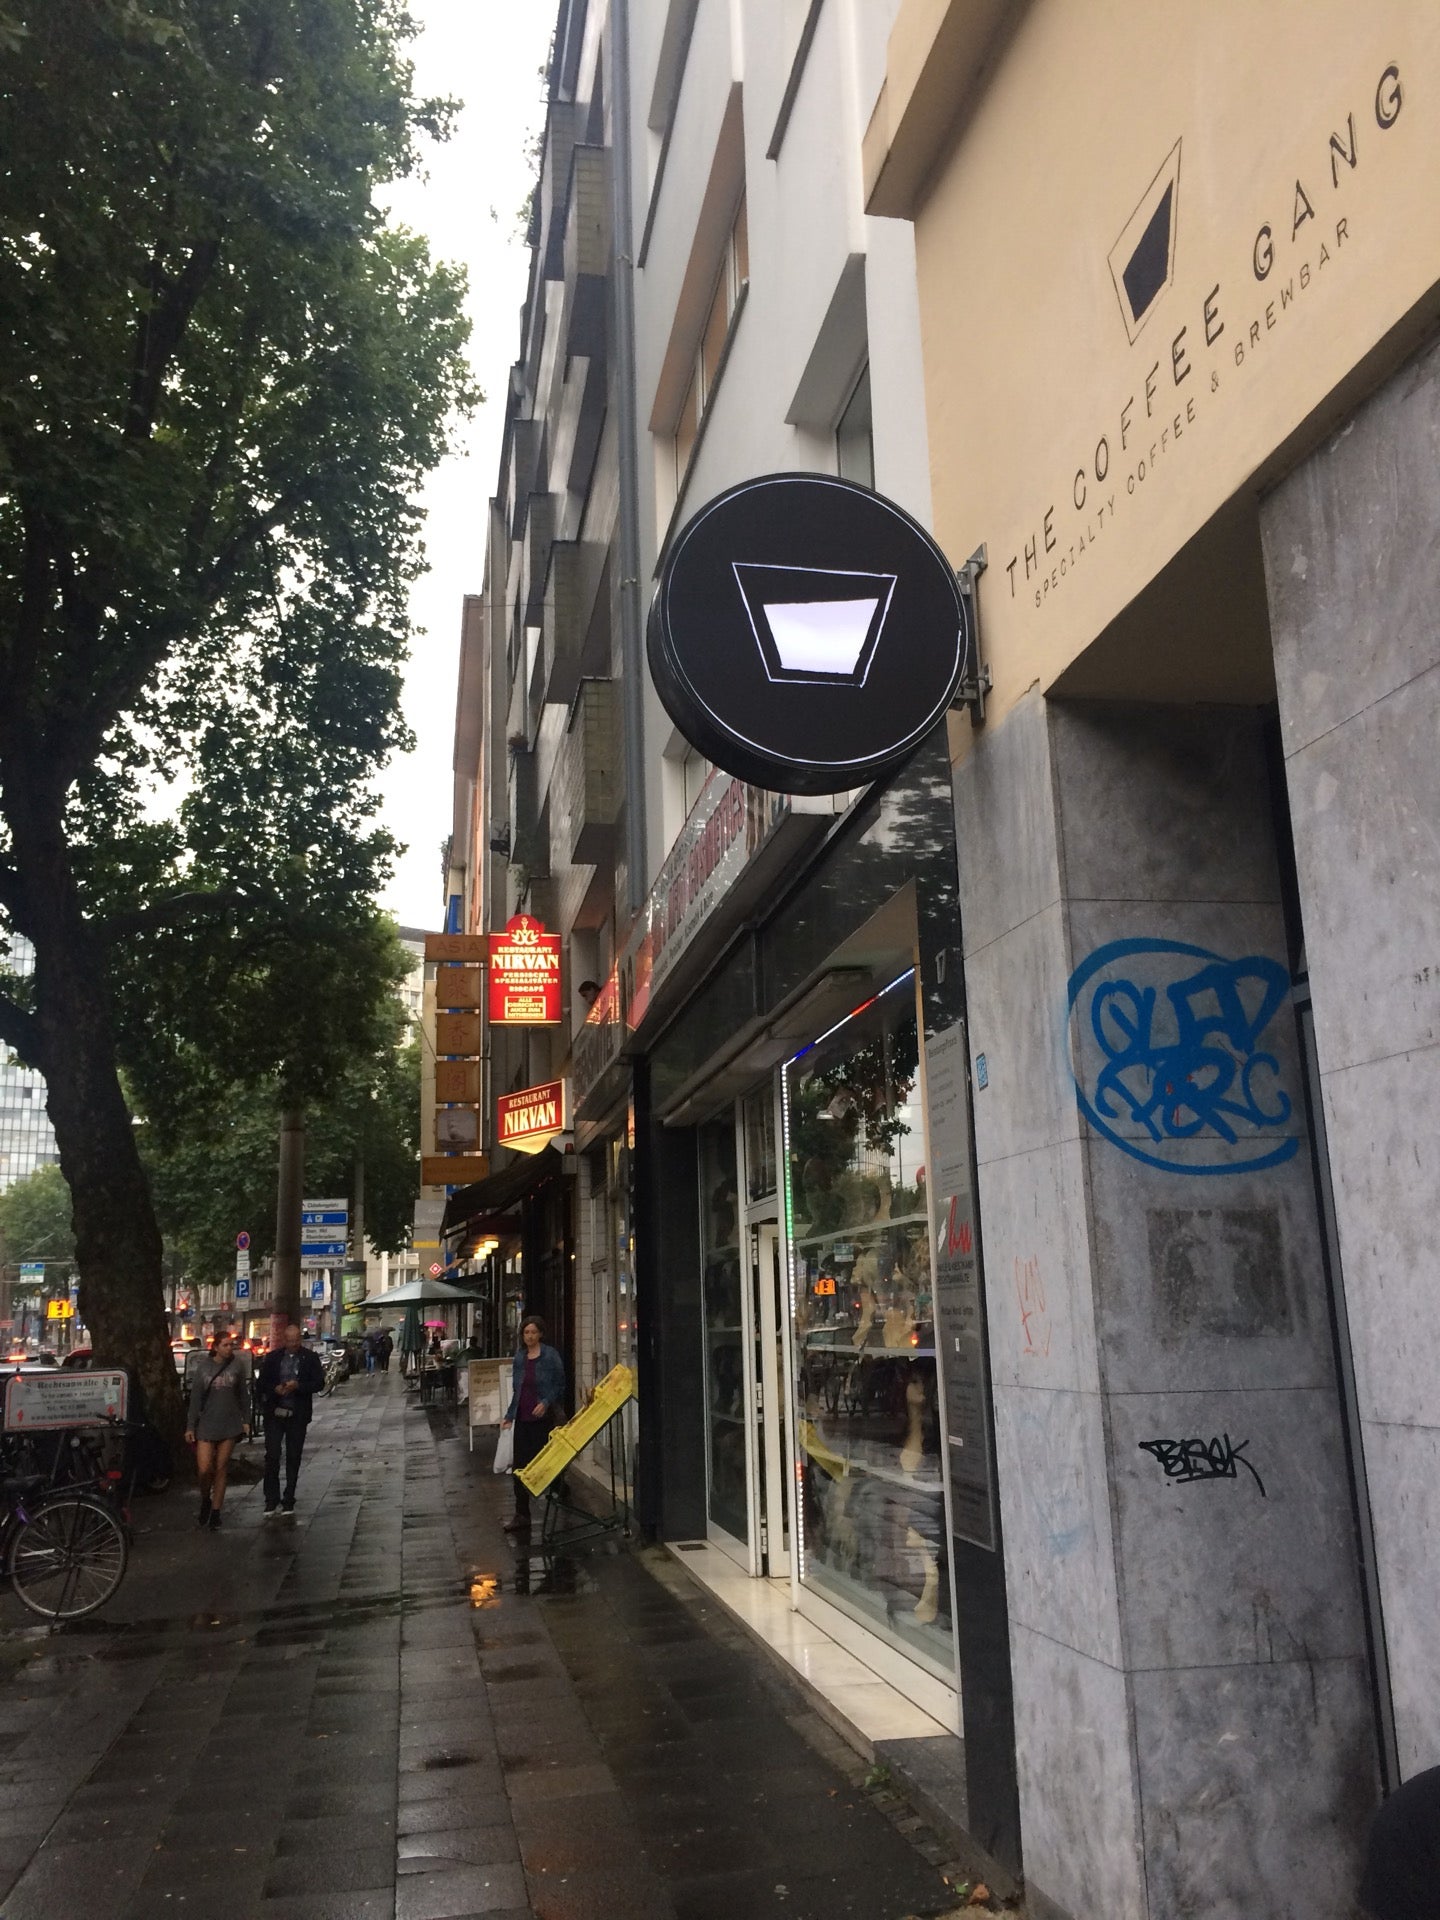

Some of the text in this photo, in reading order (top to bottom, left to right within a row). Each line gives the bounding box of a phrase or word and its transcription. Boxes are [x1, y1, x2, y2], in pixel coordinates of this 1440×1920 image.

[1005, 61, 1405, 599] THE COFFEE GANG
[1034, 217, 1351, 610] SPECIALTY COFFEE & BREWBAR
[436, 941, 481, 953] ASIA
[497, 946, 553, 954] RESTAURANT
[491, 954, 559, 970] NIRVAN
[508, 1089, 550, 1108] RESTAURANT
[504, 1101, 556, 1136] NIRVAN
[238, 1282, 247, 1296] P
[38, 1379, 98, 1389] Rechtsanwälte
